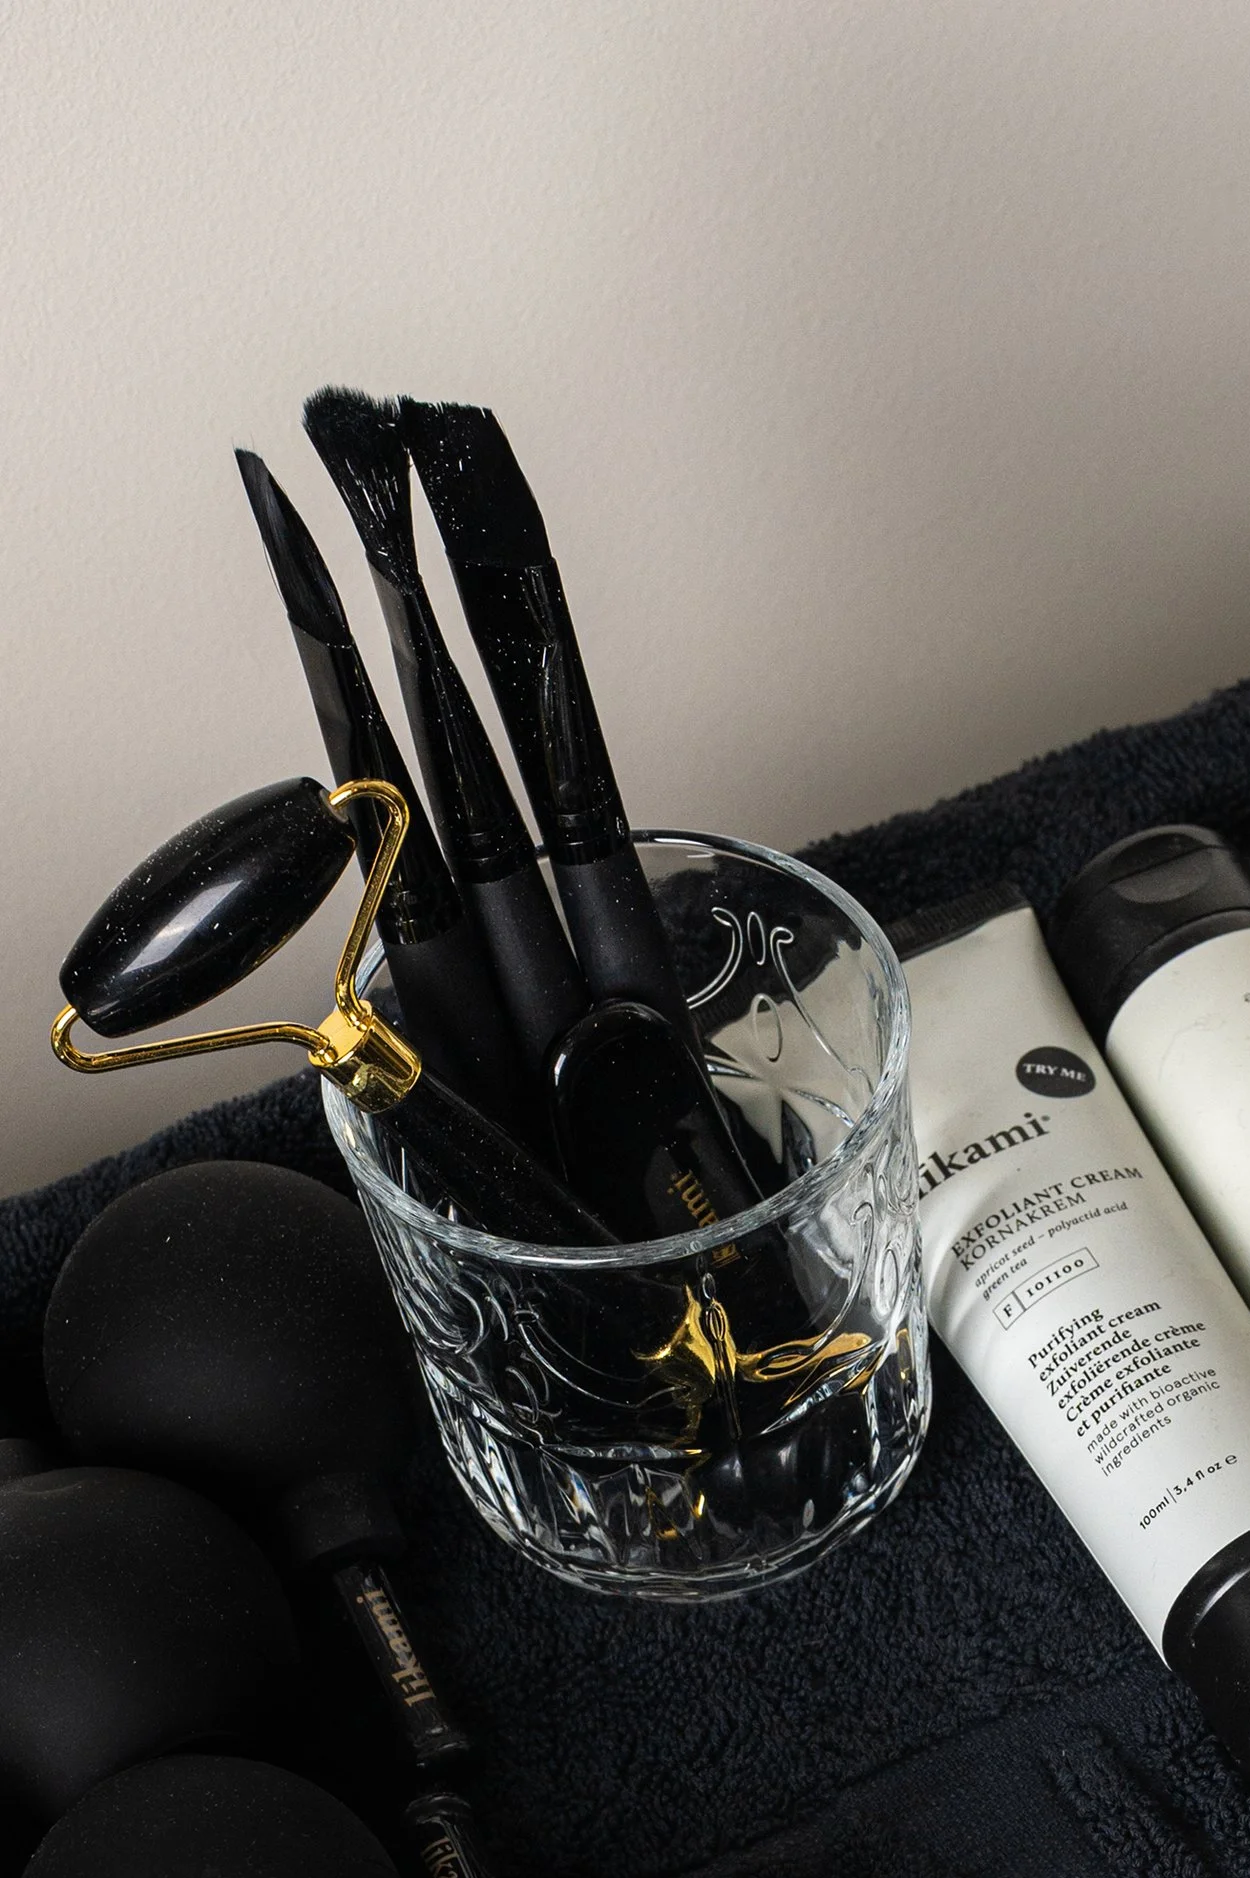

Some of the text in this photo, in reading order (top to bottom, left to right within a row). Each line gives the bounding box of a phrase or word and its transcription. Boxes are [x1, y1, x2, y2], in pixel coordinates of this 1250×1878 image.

[1022, 1061, 1088, 1083] TRY ME
[951, 1167, 1144, 1258] EXFOLIANT CREAM
[961, 1192, 1087, 1271] KORNAKREM
[975, 1201, 1129, 1287] apricot seed polyactid acid
[982, 1271, 1009, 1301] green
[1027, 1308, 1105, 1369] Purifying
[1038, 1301, 1162, 1382] exfoliant cream
[1046, 1329, 1133, 1397] Zuiverende
[1057, 1320, 1207, 1410] exfoliërende crème
[1065, 1337, 1201, 1423] Crème exfoliante
[1086, 1368, 1217, 1453] made with bioactive
[1090, 1363, 1173, 1425] purifiante
[1094, 1379, 1221, 1465] wildcrafted organic
[1101, 1414, 1173, 1477] ingredients
[1138, 1496, 1170, 1530] 100ml
